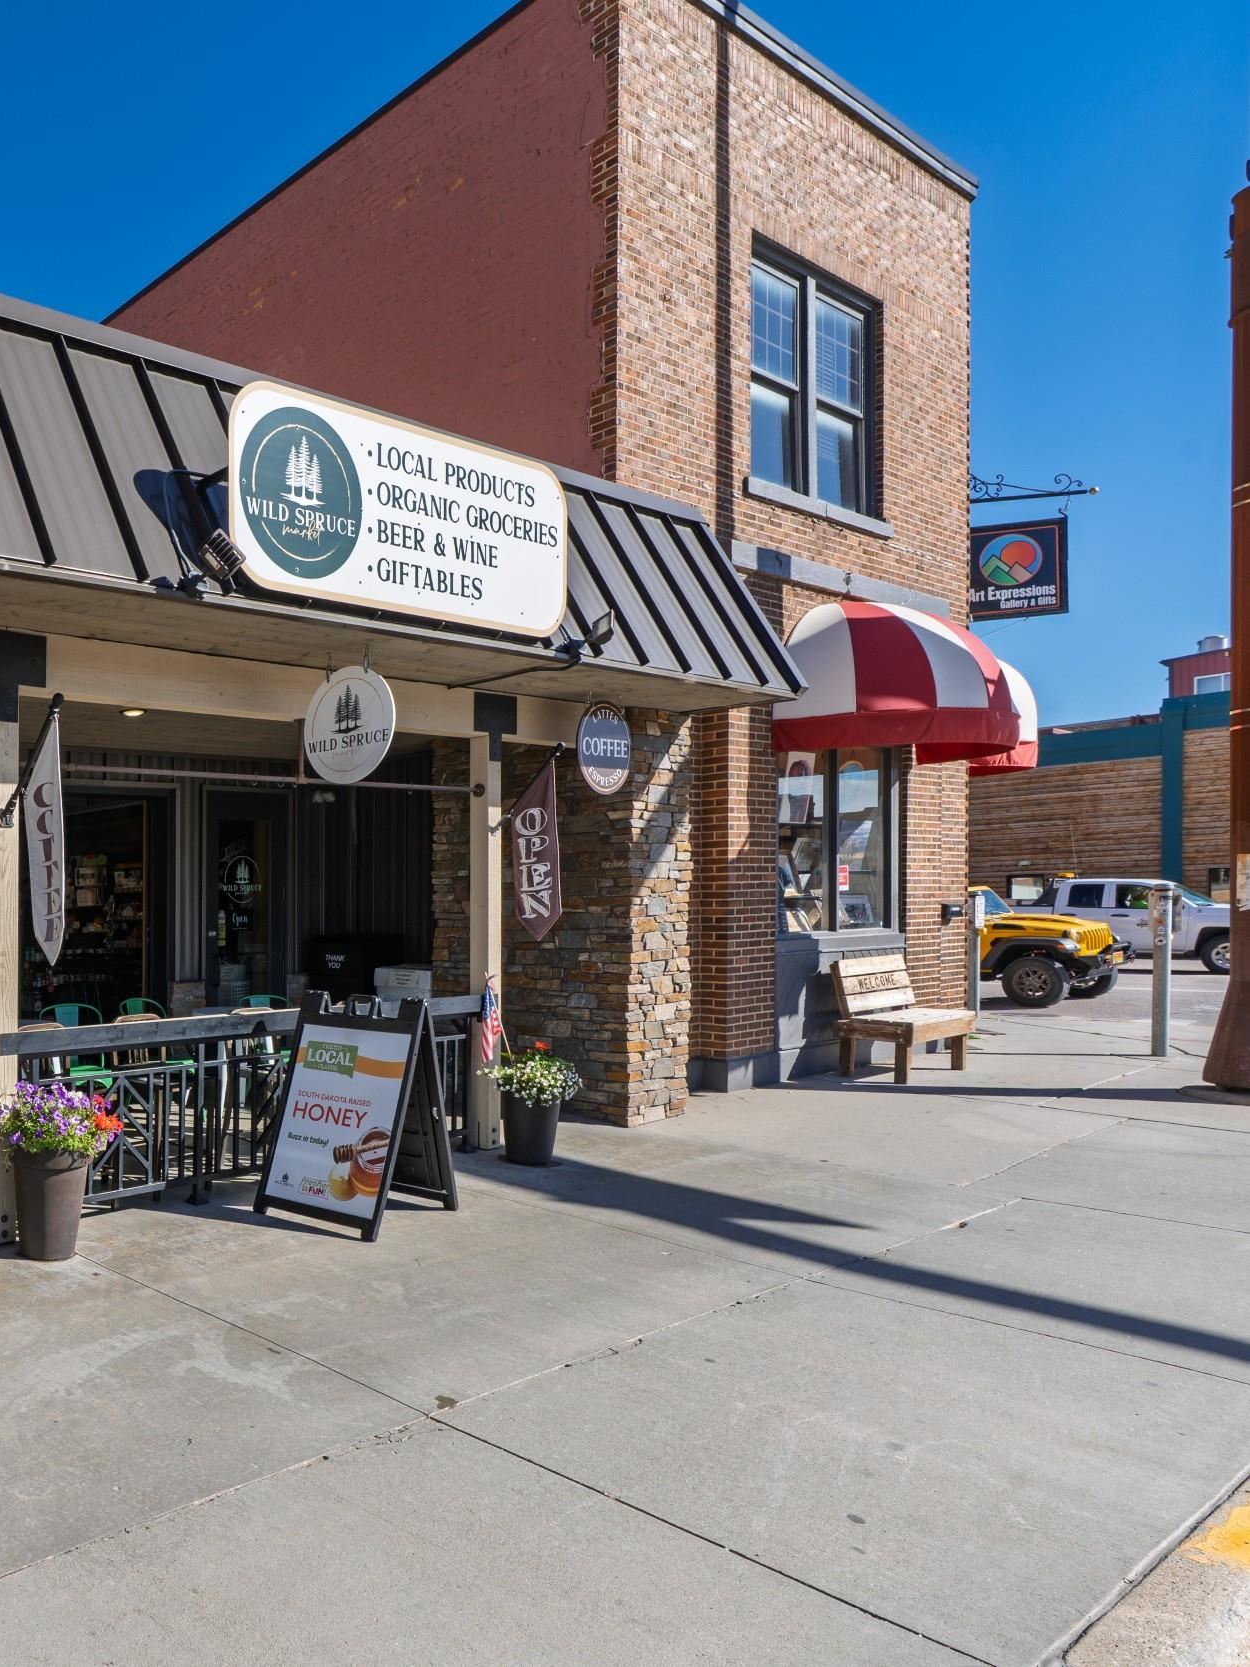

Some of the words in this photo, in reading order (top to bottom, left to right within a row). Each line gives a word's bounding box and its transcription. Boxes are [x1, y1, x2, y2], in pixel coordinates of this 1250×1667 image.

[376, 442, 438, 482] LOCAL
[444, 462, 535, 507] PRODUCTS
[246, 496, 289, 522] WILD
[295, 508, 356, 537] SPRUCE
[377, 482, 460, 523] ORGANIC
[466, 505, 558, 548] GROCERIES
[282, 520, 321, 546] market
[377, 519, 425, 552] BEER
[433, 534, 446, 557] &
[452, 536, 498, 569] WINE
[377, 557, 483, 600] GIFTABLES
[969, 588, 985, 602] Art
[988, 585, 1056, 601] Expressions
[1000, 599, 1028, 609] Gallery
[1038, 596, 1056, 605] Gifts
[593, 710, 618, 725] LATTES
[308, 738, 337, 754] WILD
[341, 728, 390, 749] SPRUCE
[583, 737, 628, 758] COFFEE
[589, 766, 622, 786] ESPRESSO
[515, 807, 552, 919] OPEN
[232, 912, 248, 927] Open
[325, 954, 345, 962] THANK
[856, 974, 896, 991] WELCOME
[307, 1048, 354, 1066] LOCAL
[298, 1090, 319, 1100] SOUTH
[320, 1093, 347, 1103] DAKOTA
[348, 1097, 372, 1107] RAISED
[292, 1100, 368, 1128] HONEY
[287, 1131, 302, 1141] Buzz
[310, 1136, 329, 1148] today!
